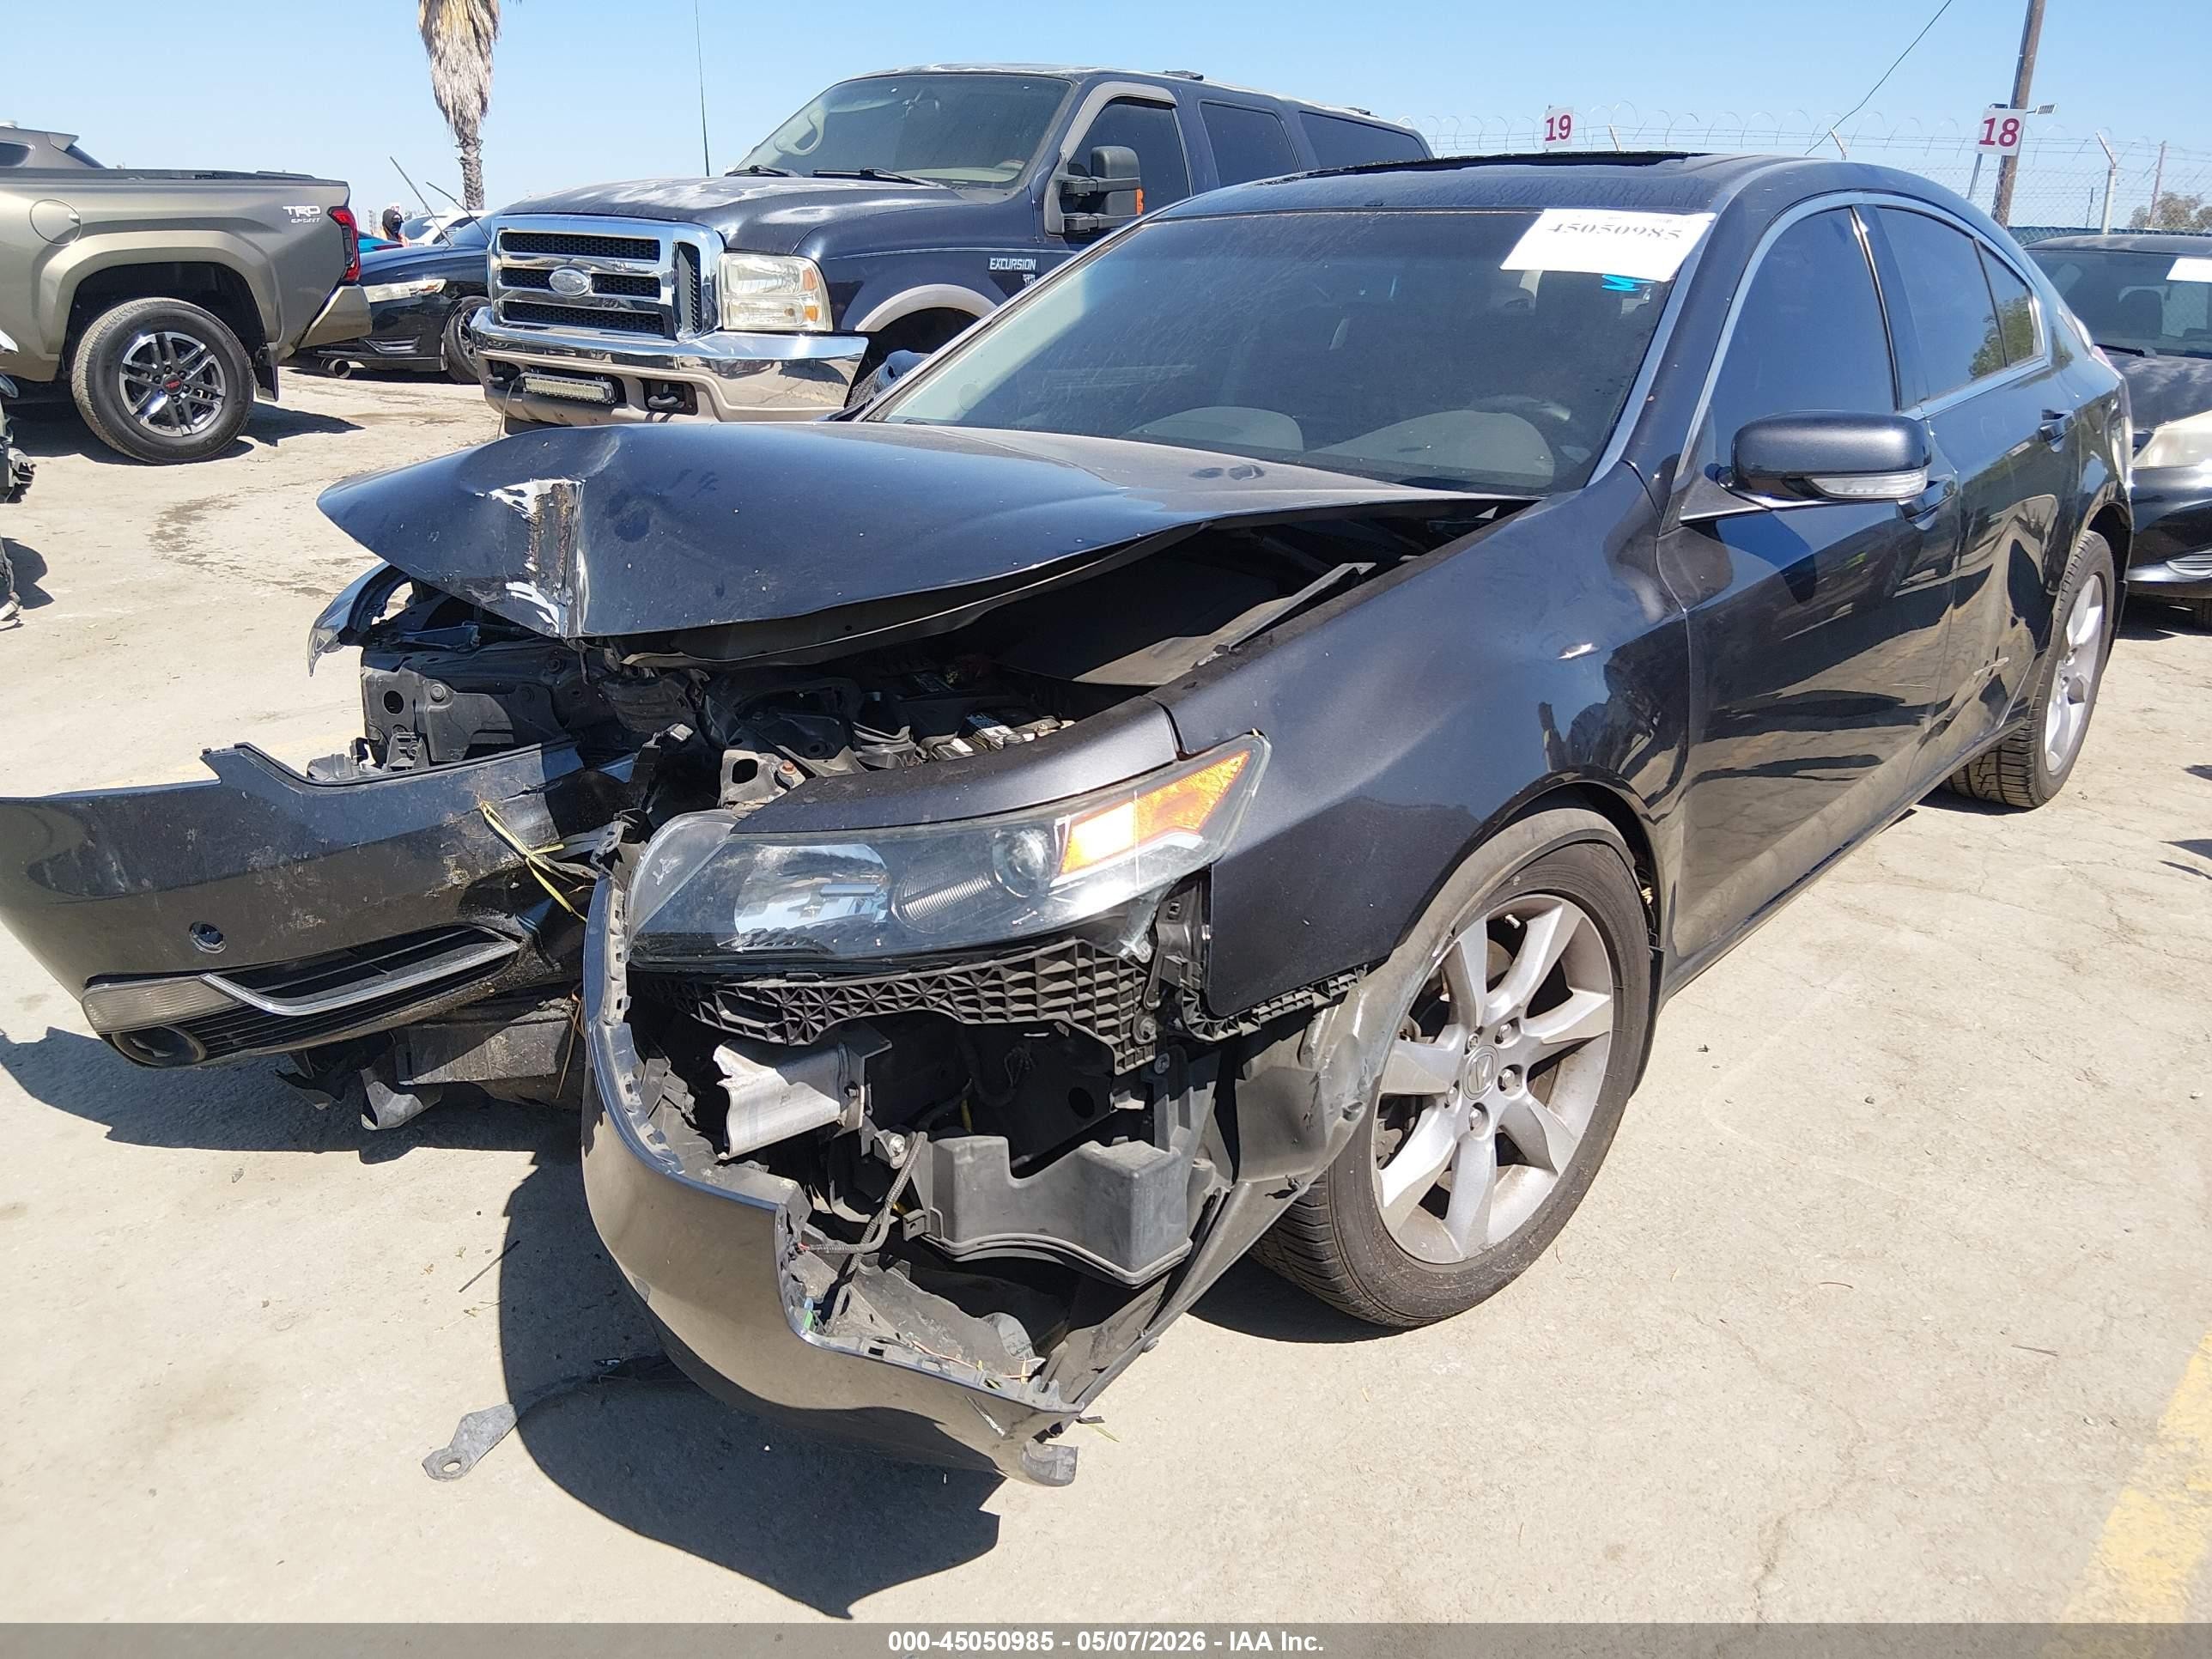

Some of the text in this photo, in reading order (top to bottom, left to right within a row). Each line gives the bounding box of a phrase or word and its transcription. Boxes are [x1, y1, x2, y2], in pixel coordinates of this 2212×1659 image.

[1545, 114, 1571, 142] 19
[1978, 117, 2021, 147] 18
[282, 205, 321, 217] TRD
[1547, 222, 1684, 240] 45050985
[988, 257, 1036, 270] EXCURSION
